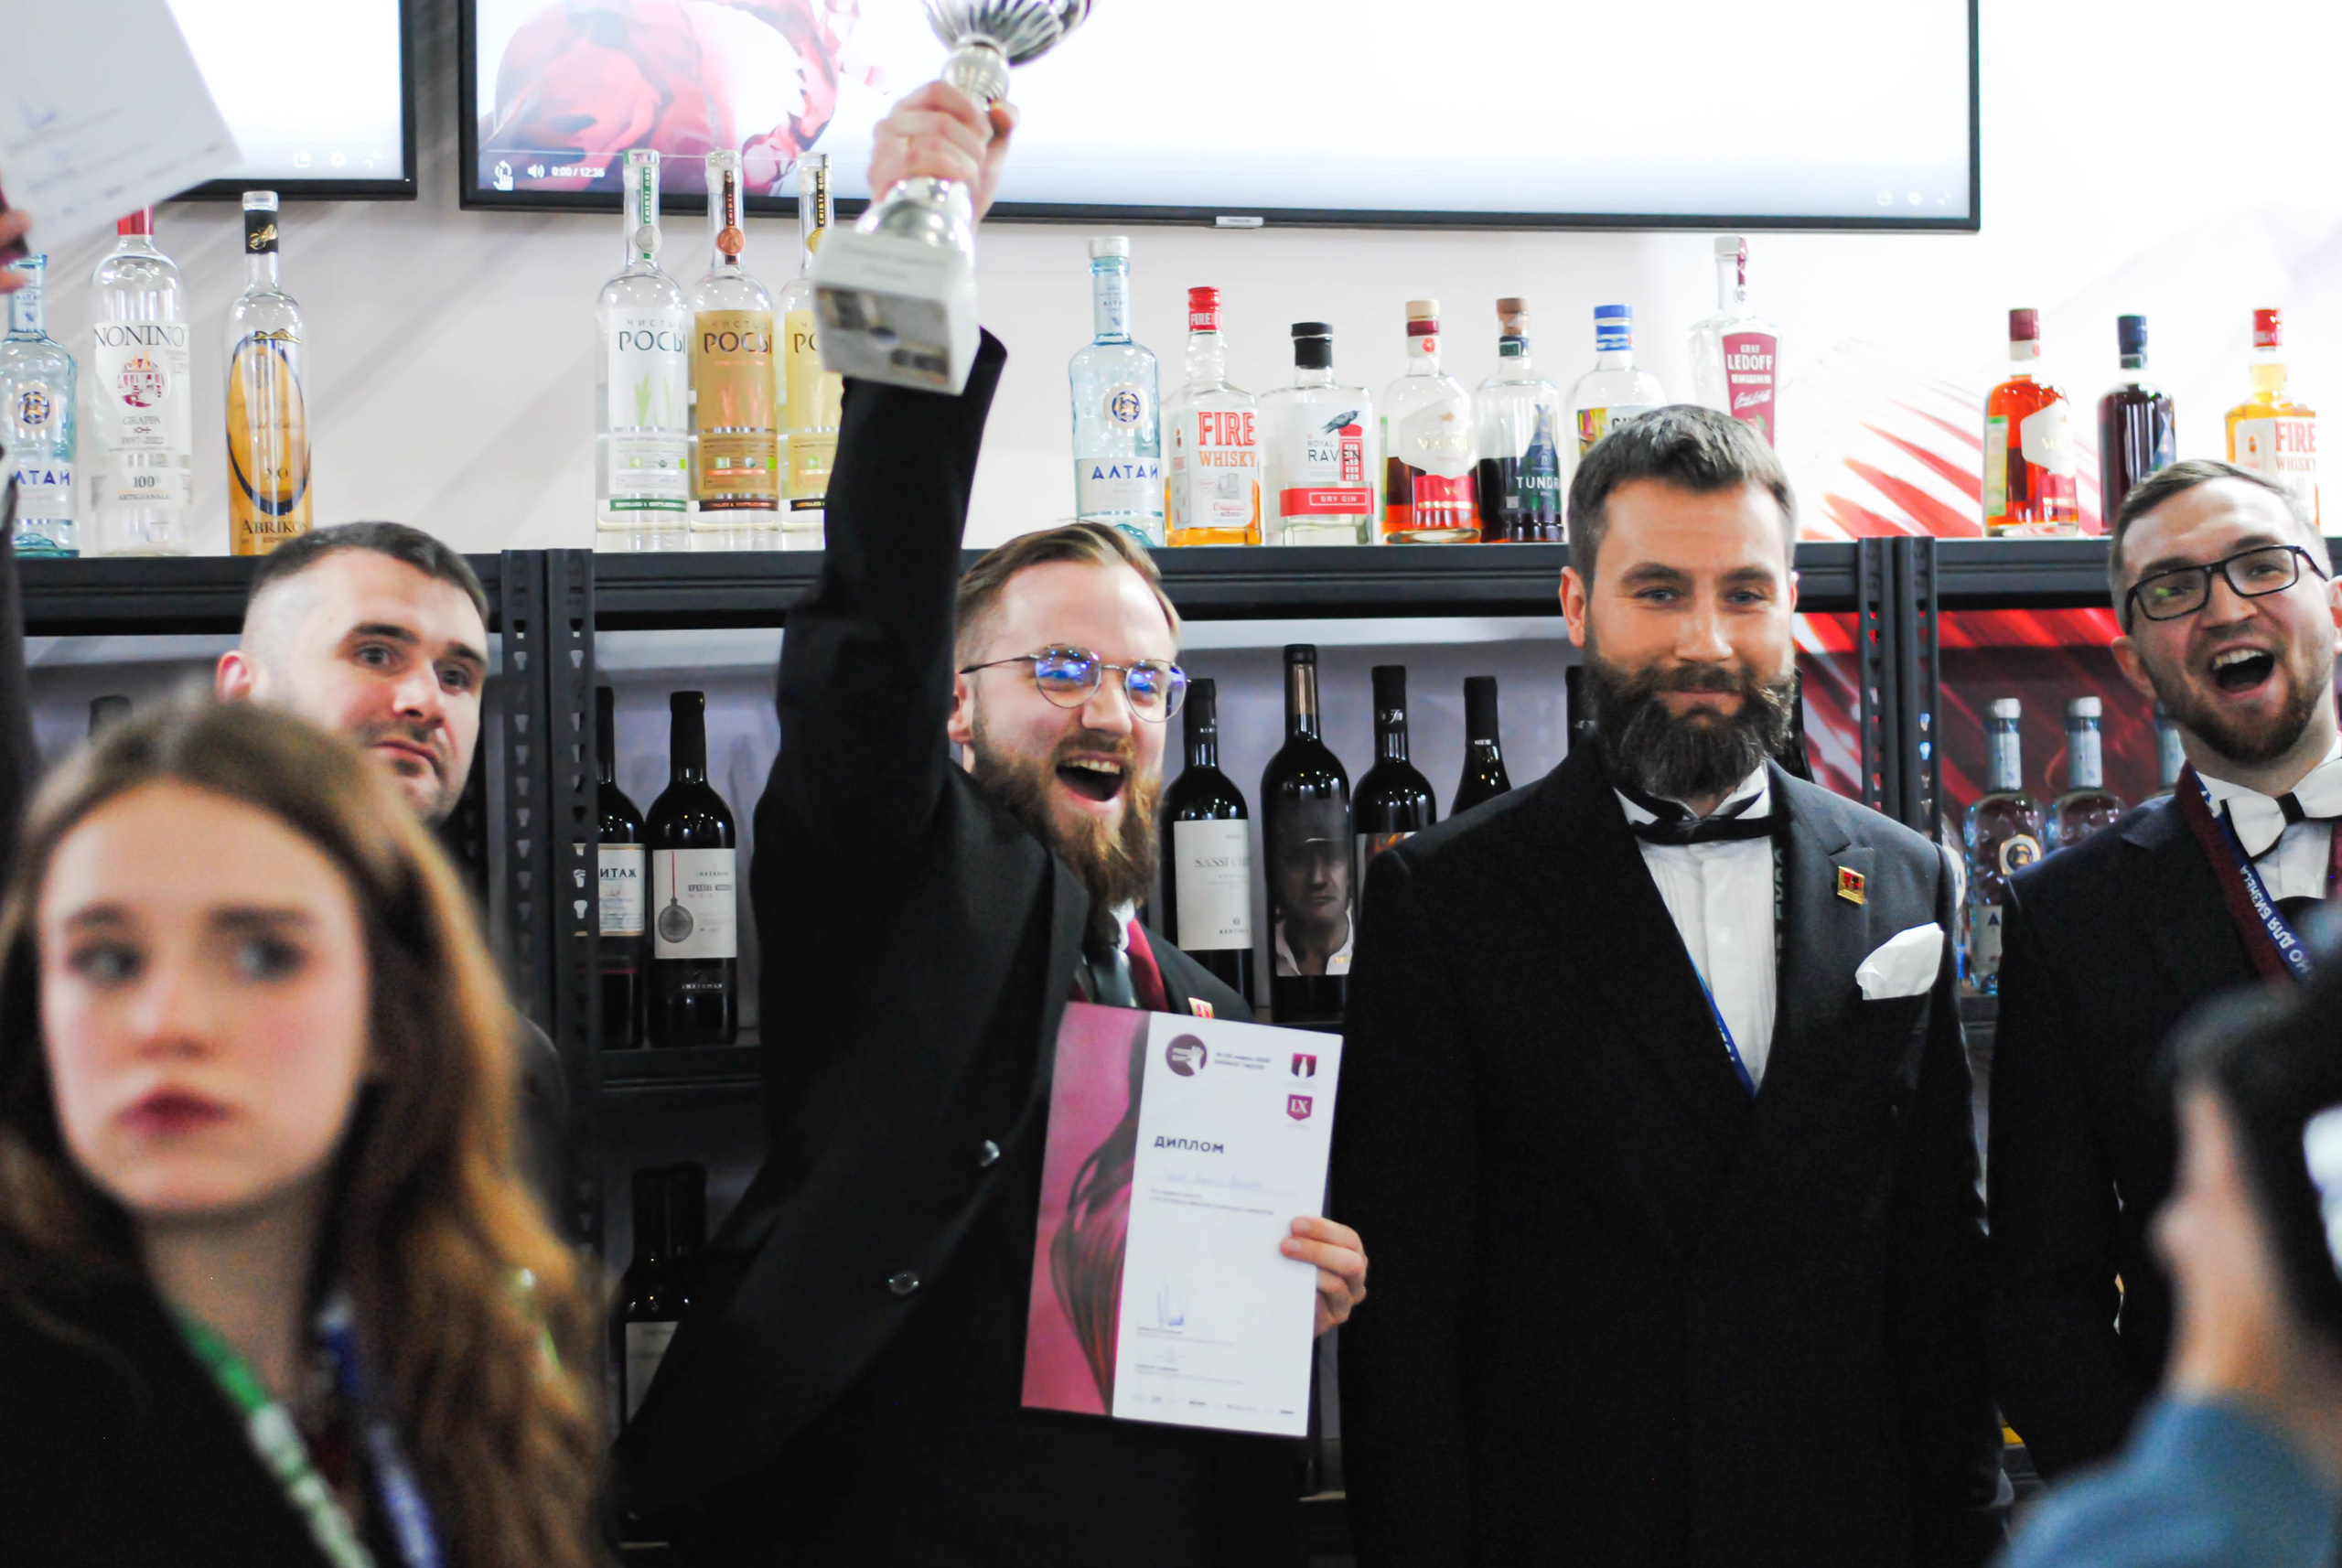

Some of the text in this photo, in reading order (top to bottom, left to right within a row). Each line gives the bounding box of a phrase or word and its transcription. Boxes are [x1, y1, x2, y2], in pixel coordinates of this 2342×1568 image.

[93, 325, 185, 348] NONINO
[618, 330, 686, 353] РОСЫ
[704, 331, 772, 354] РОСЫ
[1727, 354, 1773, 371] LEDOFF
[122, 415, 161, 425] GRAPPA
[1198, 412, 1256, 446] FIRE
[2275, 422, 2316, 452] FIRE
[1198, 451, 1256, 467] WHISKY
[1307, 448, 1361, 462] RAVEN
[15, 467, 70, 486] ЛТАЙ
[1091, 465, 1157, 480] АЛТАЙ
[1516, 476, 1559, 489] TUNDR
[600, 867, 637, 878] ИТАЖ
[2239, 865, 2272, 920] БИЗНЕСА
[2266, 916, 2296, 950] ДЛЯ
[1154, 1135, 1224, 1154] ДИПЛОМ
